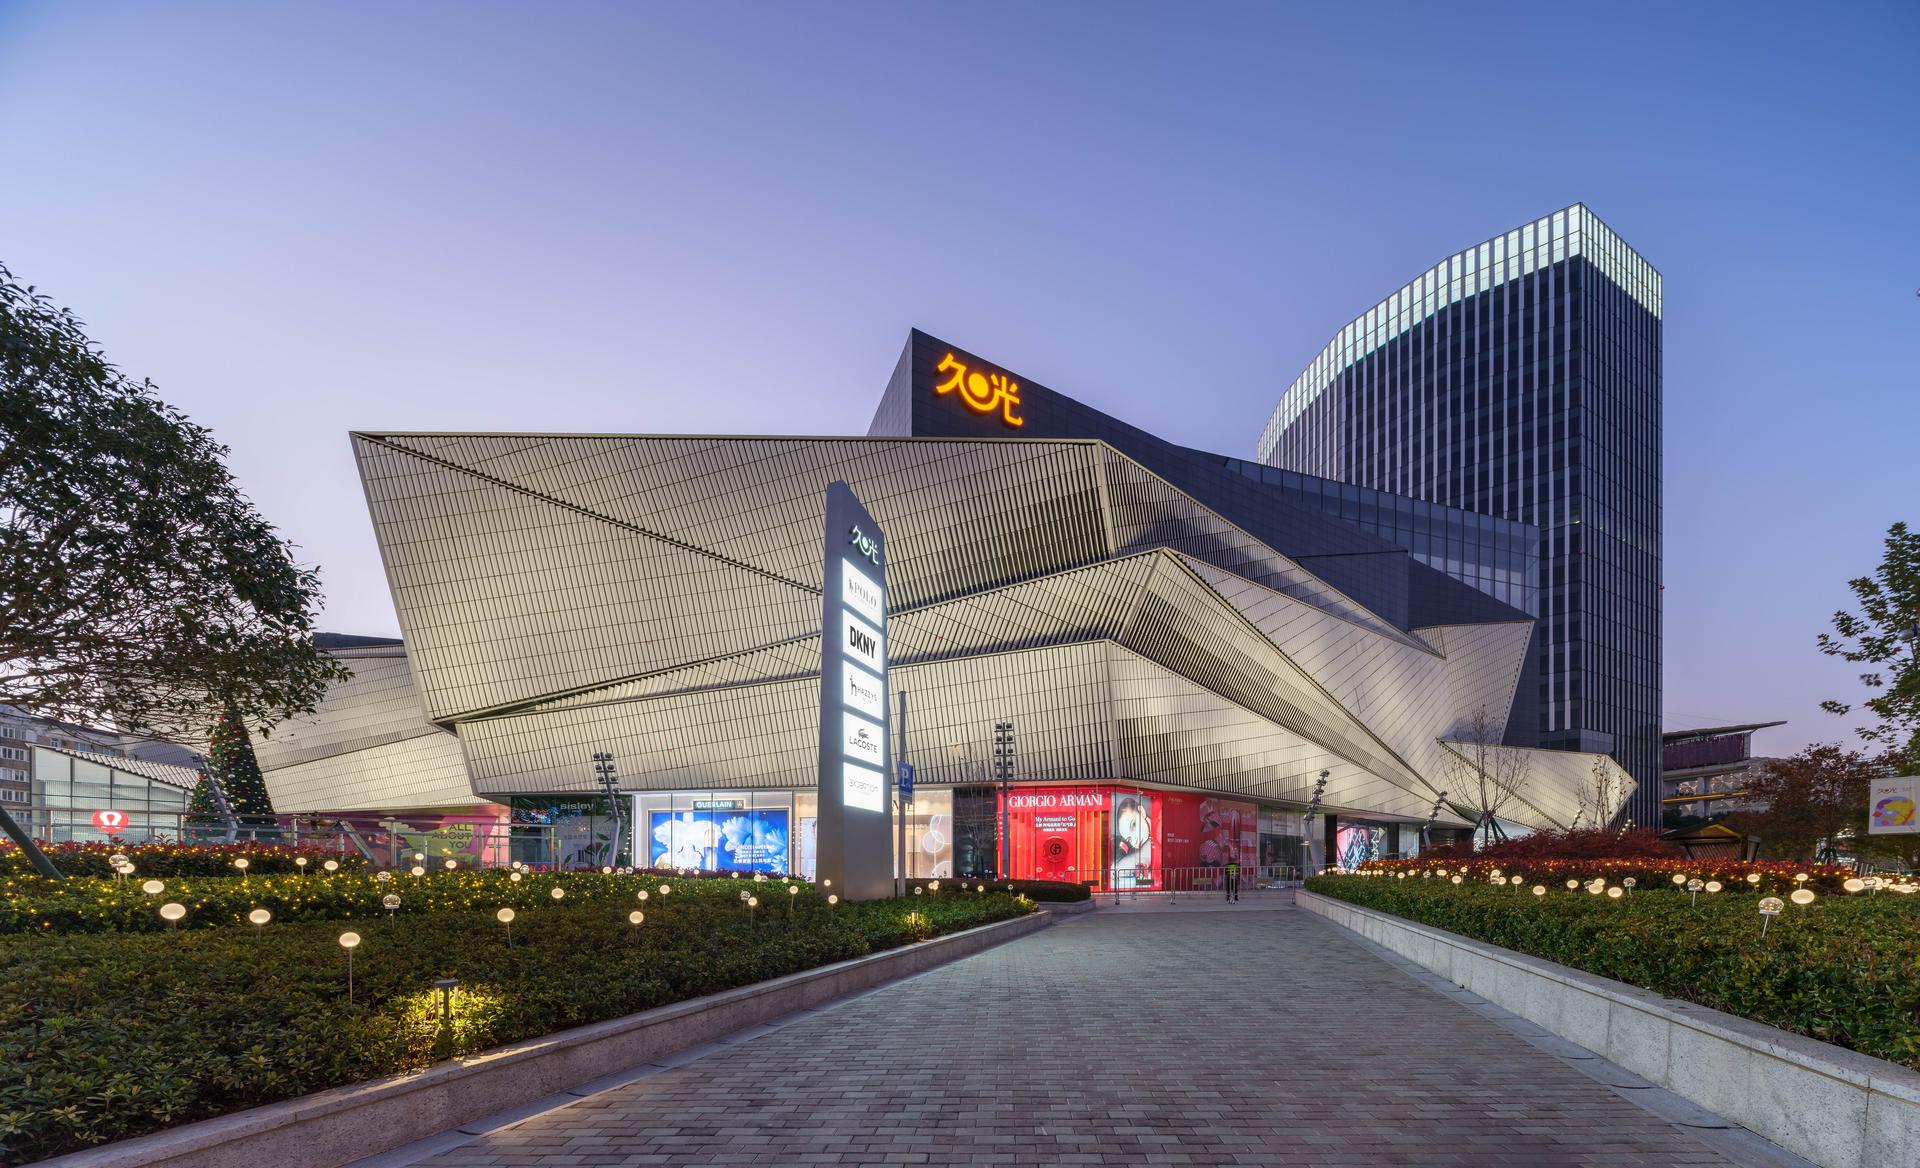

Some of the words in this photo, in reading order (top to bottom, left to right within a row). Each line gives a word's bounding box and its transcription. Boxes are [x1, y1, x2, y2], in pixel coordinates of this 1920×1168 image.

[935, 352, 1024, 427] 久光
[852, 525, 879, 565] 久光
[854, 581, 877, 608] POLO
[849, 625, 876, 659] DKNY
[856, 685, 878, 702] HAZZYS
[849, 735, 878, 754] LACOSTE
[901, 767, 909, 788] P
[560, 801, 594, 811] sisley
[1009, 795, 1056, 808] GIORGIO
[1059, 794, 1103, 807] ARMANI
[431, 832, 473, 841] ABOUT
[449, 823, 472, 832] ALL
[449, 841, 472, 849] YOU
